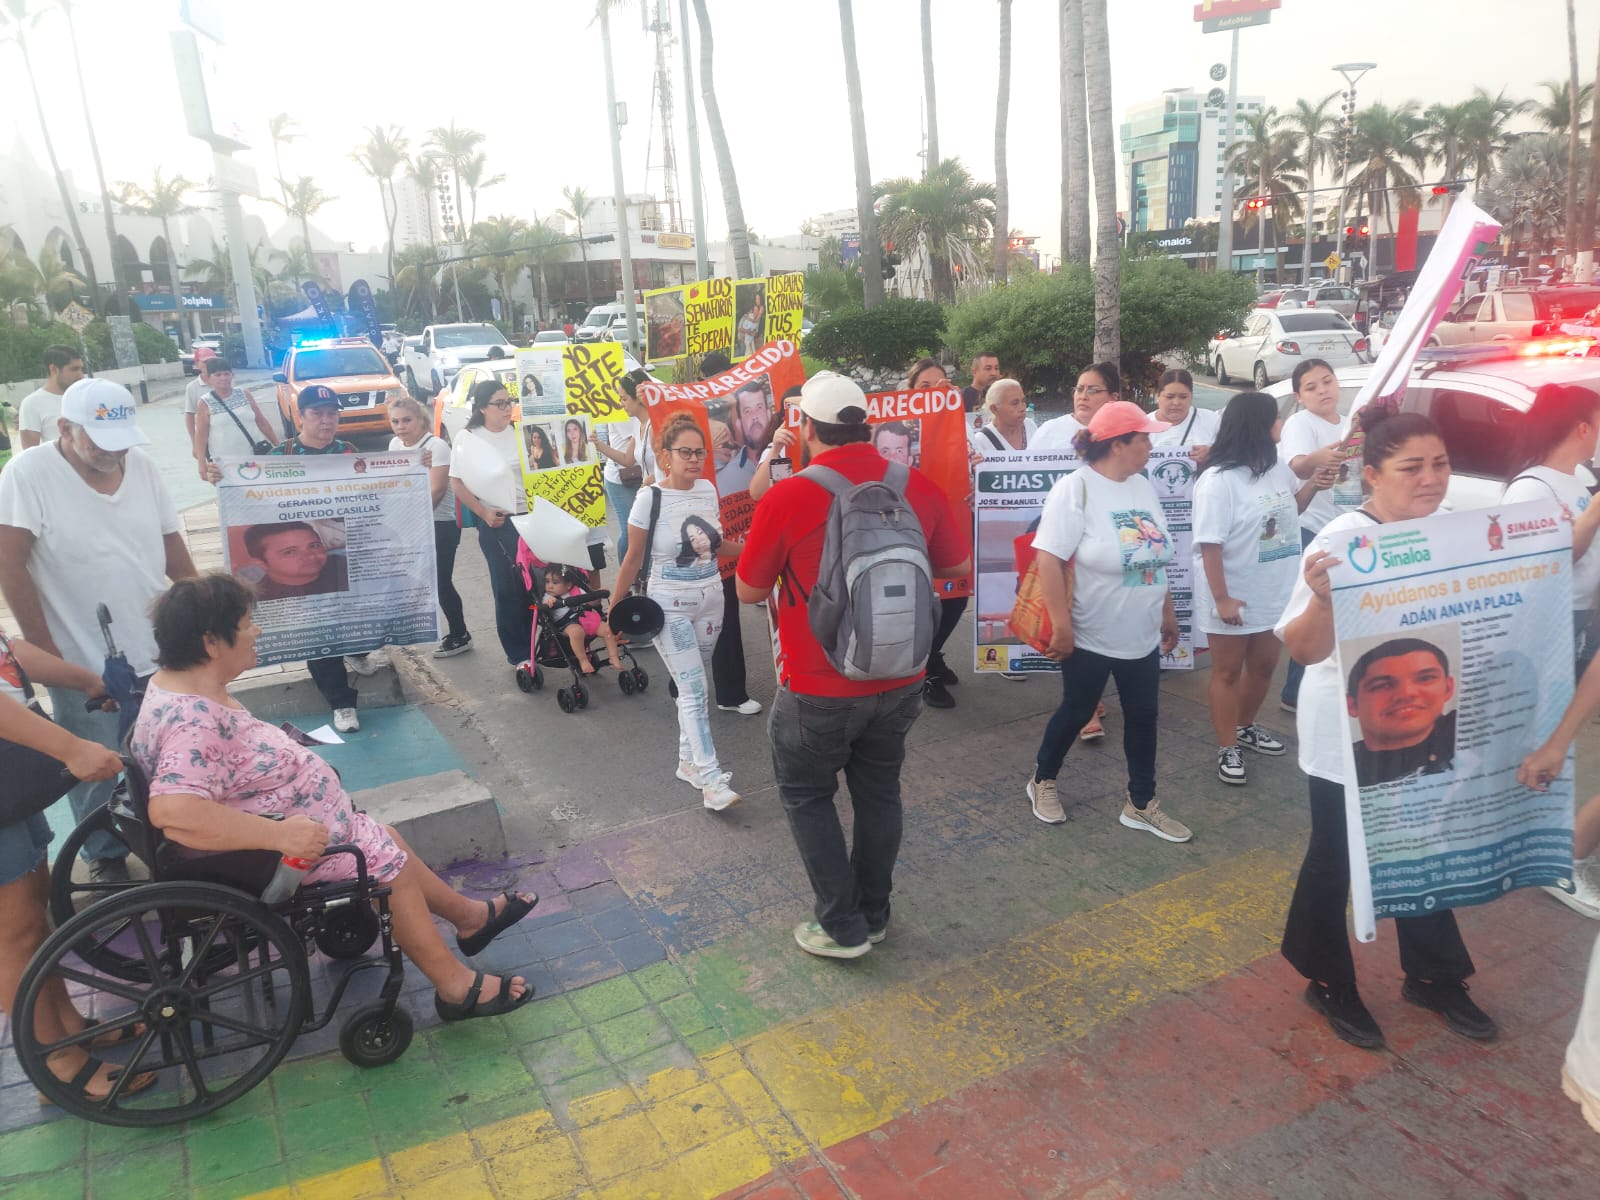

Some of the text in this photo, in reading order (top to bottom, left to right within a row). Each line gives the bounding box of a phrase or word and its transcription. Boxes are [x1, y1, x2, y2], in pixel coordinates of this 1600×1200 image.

[707, 277, 731, 298] LOS
[182, 296, 213, 307] Dolphy
[685, 323, 700, 336] TE
[769, 312, 792, 335] TUS
[687, 326, 732, 356] ESPERAN
[563, 345, 591, 371] YO
[643, 339, 796, 407] DESAPARECIDO
[370, 458, 410, 466] SINALOA
[1008, 455, 1023, 463] LUZ
[1033, 454, 1079, 462] ESPERANZA
[265, 469, 306, 479] Sinaloa
[991, 473, 1044, 490] ¿HAS
[246, 479, 412, 500] Ayúdanos a encontrar a
[278, 494, 380, 509] GERARDO MICHAEL
[978, 498, 999, 506] JOSE
[1001, 498, 1039, 506] EMANUEL
[278, 504, 381, 521] QUEVEDO CASILLAS
[1506, 517, 1558, 534] SINALOA
[1381, 547, 1431, 569] Sinaloa
[1360, 561, 1561, 613] Ayúdanos a encontrar a
[1399, 591, 1523, 627] ADÁN ANAYA PLAZA
[1373, 904, 1389, 914] 27
